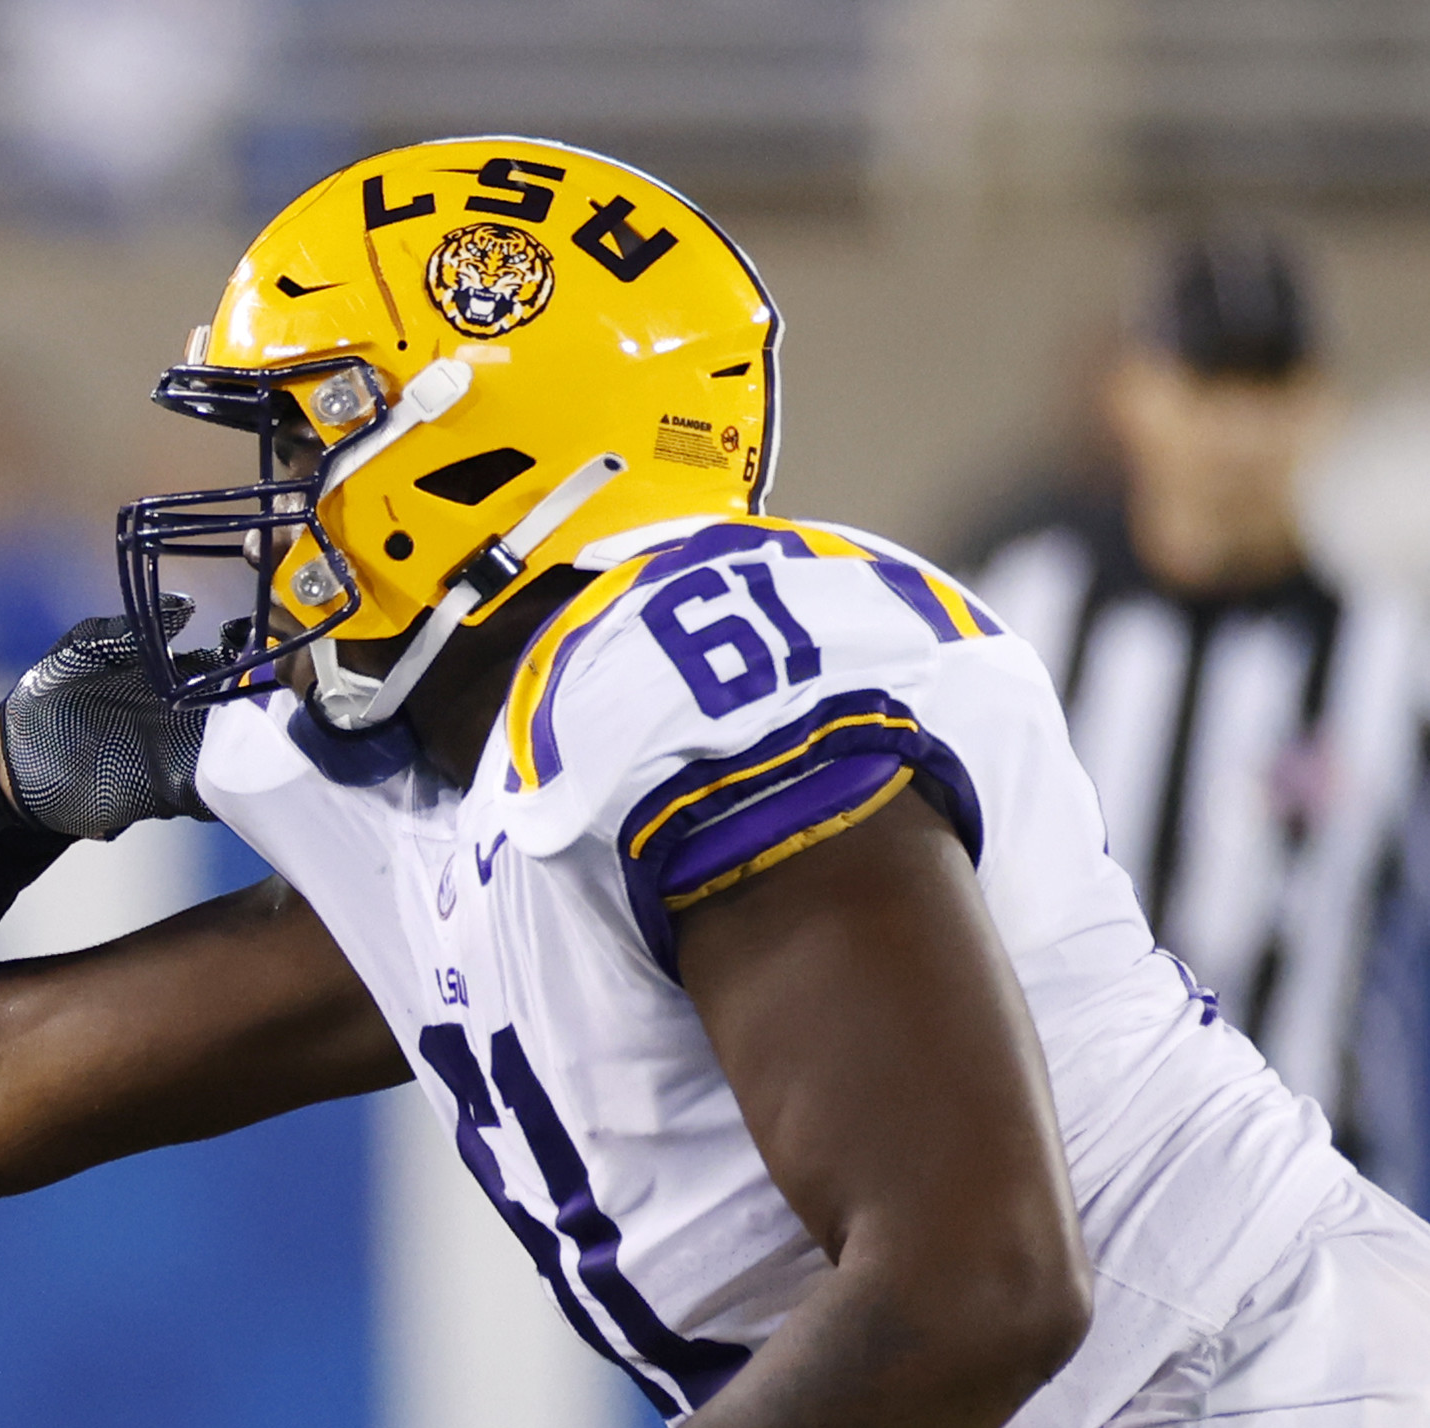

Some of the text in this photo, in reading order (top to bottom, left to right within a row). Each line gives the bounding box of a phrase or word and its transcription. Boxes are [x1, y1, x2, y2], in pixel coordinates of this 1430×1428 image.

[363, 157, 680, 282] LSU
[672, 416, 712, 431] DANGER
[640, 562, 821, 720] 61
[435, 967, 469, 1008] LSU
